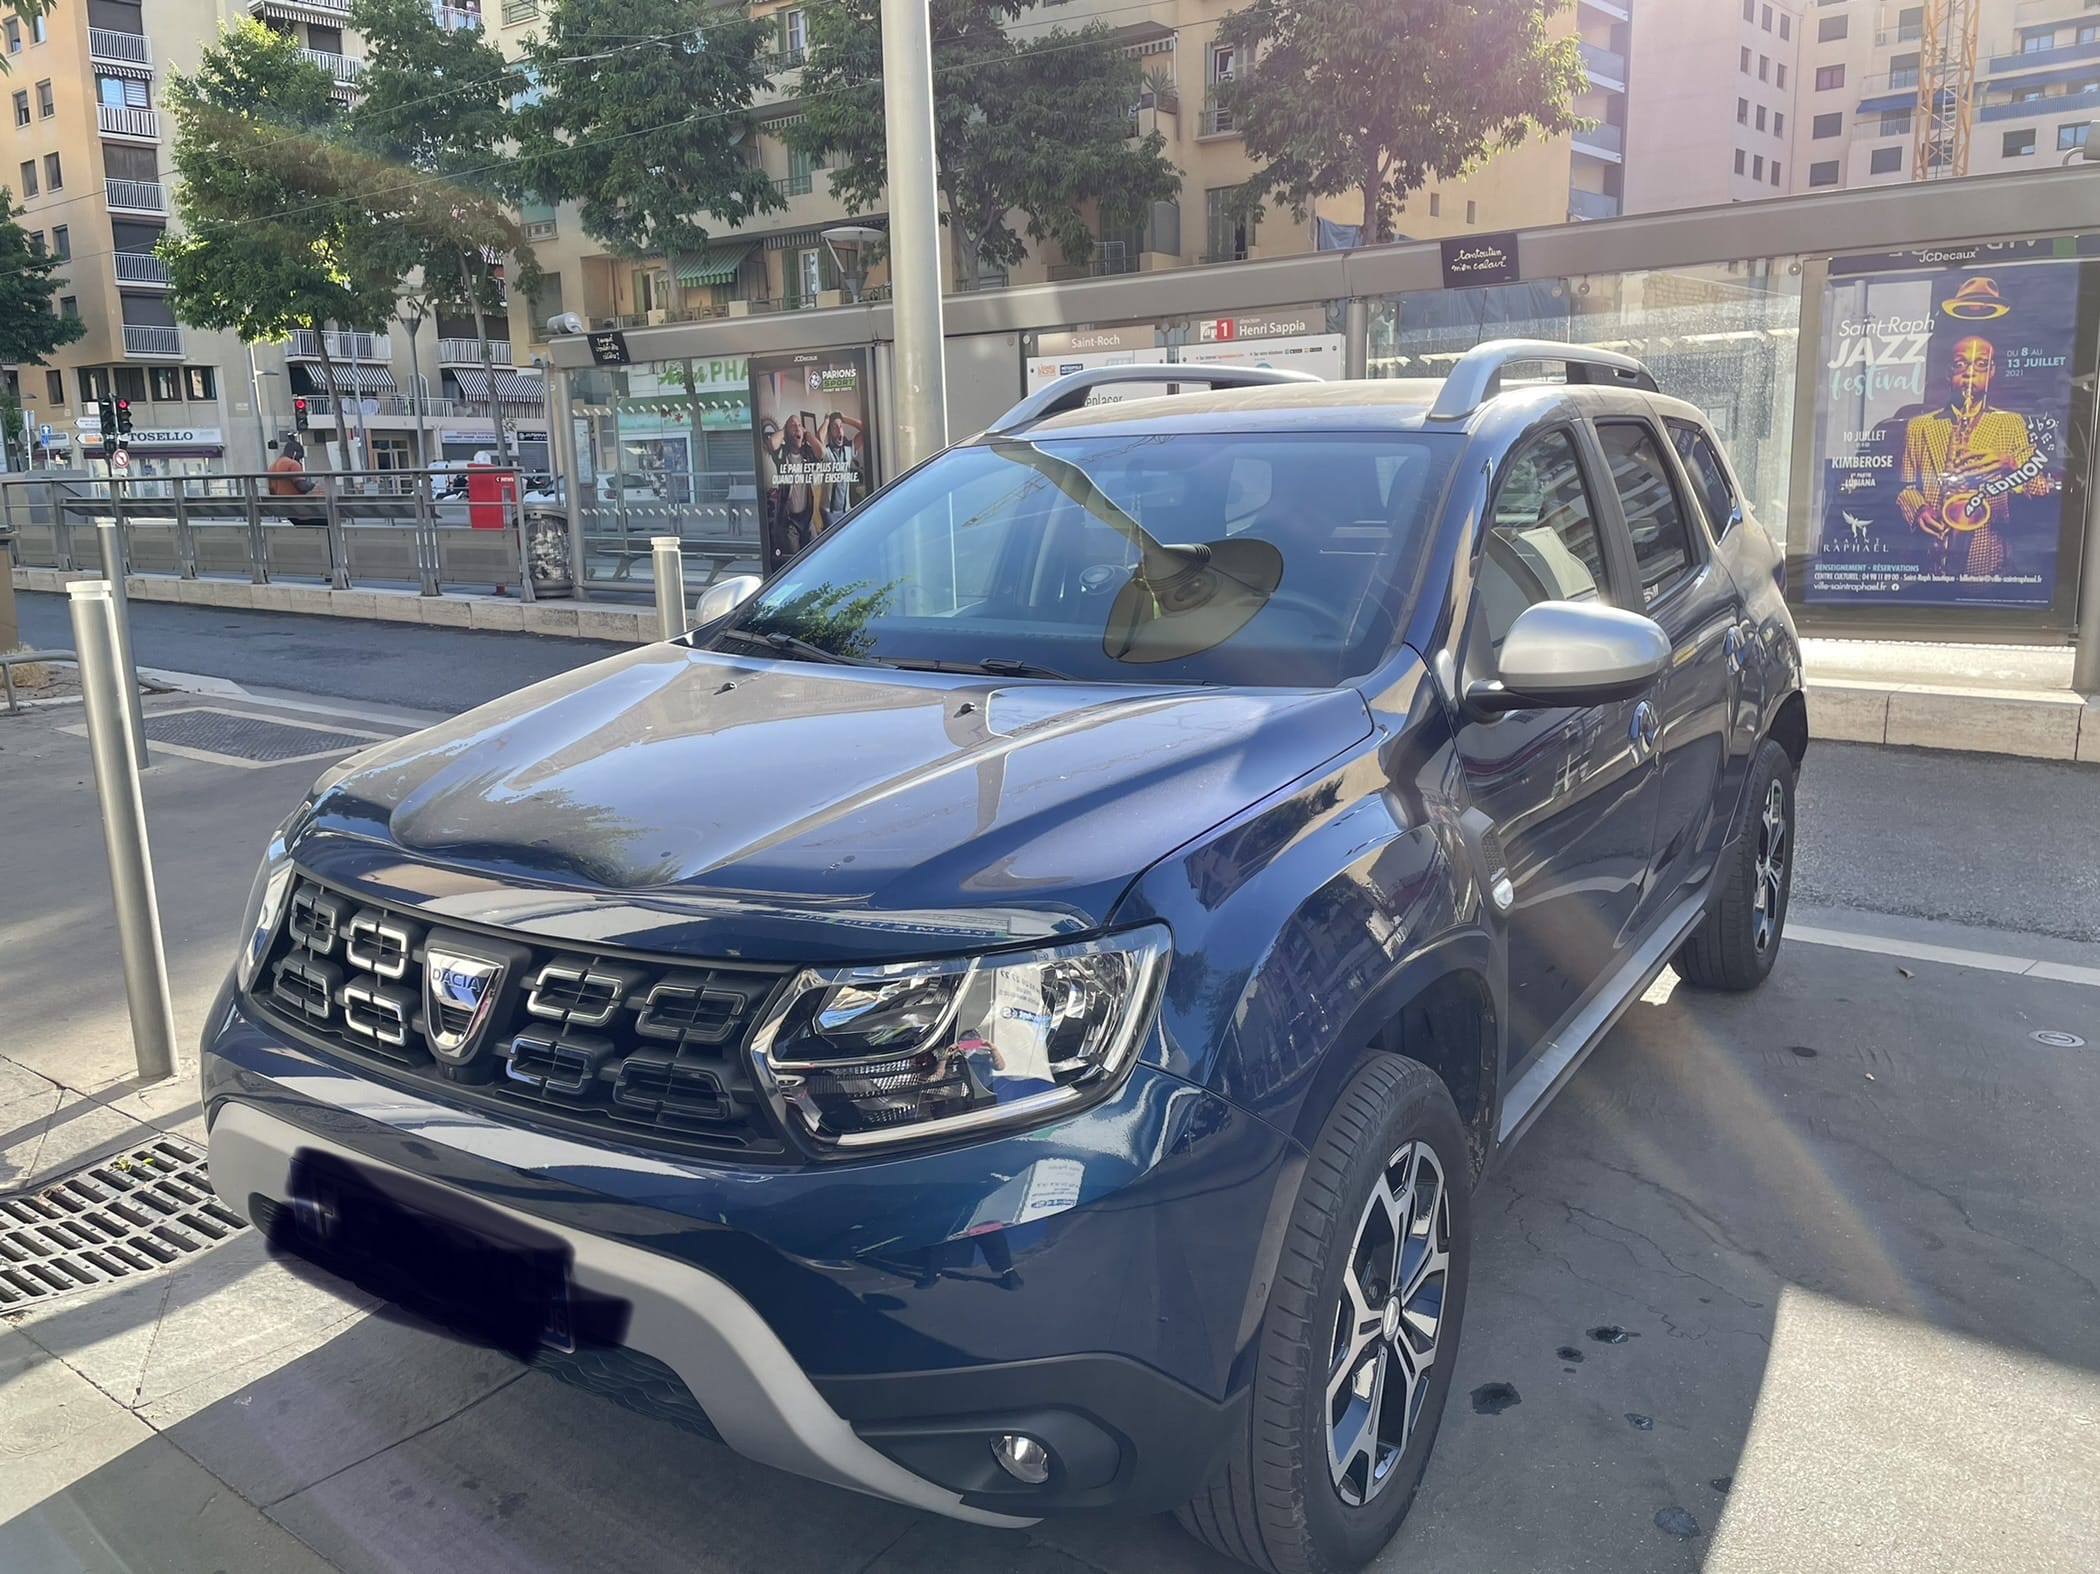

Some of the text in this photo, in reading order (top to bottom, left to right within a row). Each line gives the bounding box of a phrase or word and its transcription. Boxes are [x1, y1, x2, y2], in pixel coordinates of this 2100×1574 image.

[1919, 250, 1977, 263] JCDecaux
[1221, 322, 1228, 337] 1
[1239, 323, 1267, 336] Henri
[1269, 319, 1306, 335] Sappia
[1071, 334, 1121, 349] Saint-Roch
[1826, 332, 1934, 369] JAZZ
[2021, 347, 2029, 357] 8
[2030, 348, 2043, 356] AU
[2008, 356, 2067, 369] 13 JUILLET
[822, 369, 857, 380] PARIONS
[2005, 369, 2024, 377] 2021
[824, 379, 855, 388] SPORT
[1831, 361, 1926, 401] festival
[129, 431, 194, 442] TOSELLO
[1843, 430, 1887, 442] 10 JUILLET
[788, 463, 803, 473] PARI
[804, 462, 816, 472] EST
[816, 462, 832, 472] PLUS
[832, 461, 850, 472] FORT
[1831, 455, 1894, 469] KIMBEROSE
[772, 474, 794, 485] QUAND
[795, 474, 805, 484] ON
[805, 473, 813, 484] LE
[1872, 563, 1920, 572] RÉSERVATIONS
[1813, 581, 1888, 593] ville-saintraphael.fr
[432, 968, 480, 992] DACIA
